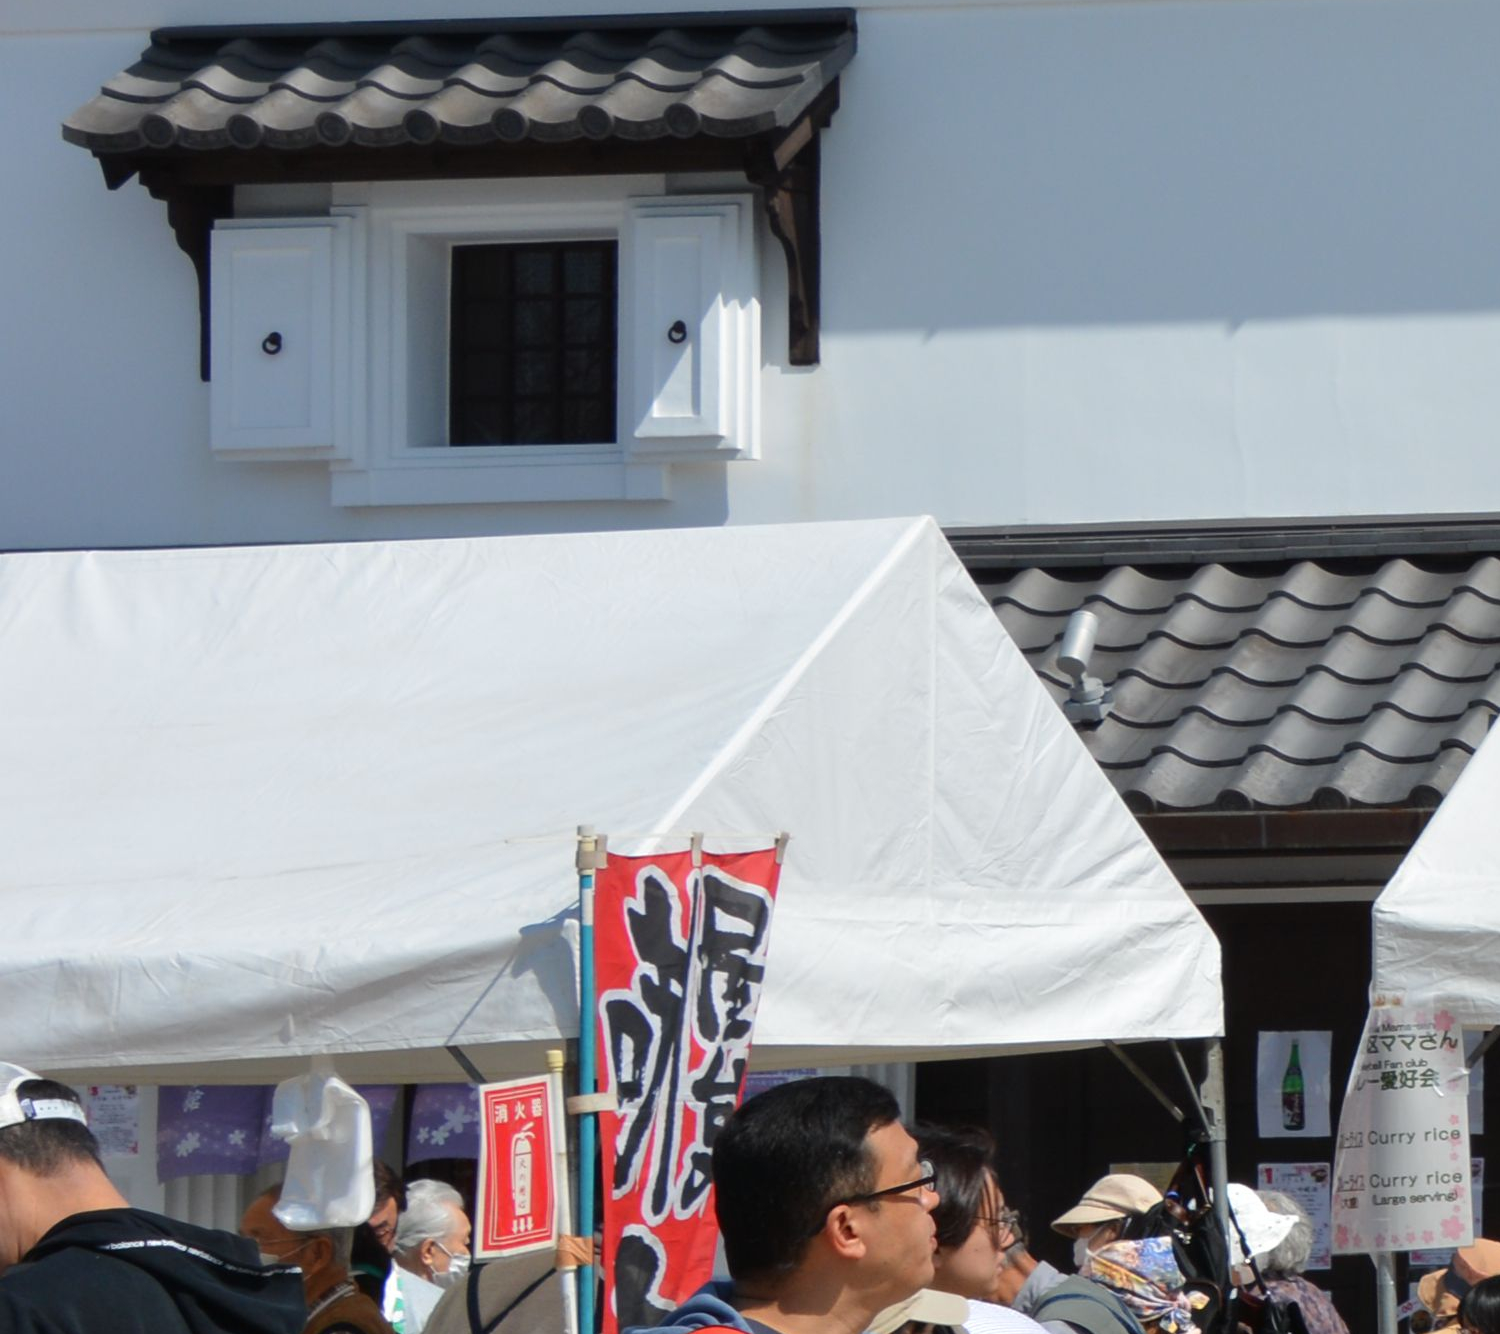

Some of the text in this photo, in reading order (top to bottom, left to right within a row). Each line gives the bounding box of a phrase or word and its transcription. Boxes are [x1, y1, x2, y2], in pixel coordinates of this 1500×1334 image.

[495, 1099, 543, 1124] 消火器
[1368, 1130, 1415, 1145] Curry
[1425, 1128, 1461, 1141] rice
[1369, 1173, 1418, 1188] Curry
[1427, 1171, 1463, 1184] rice
